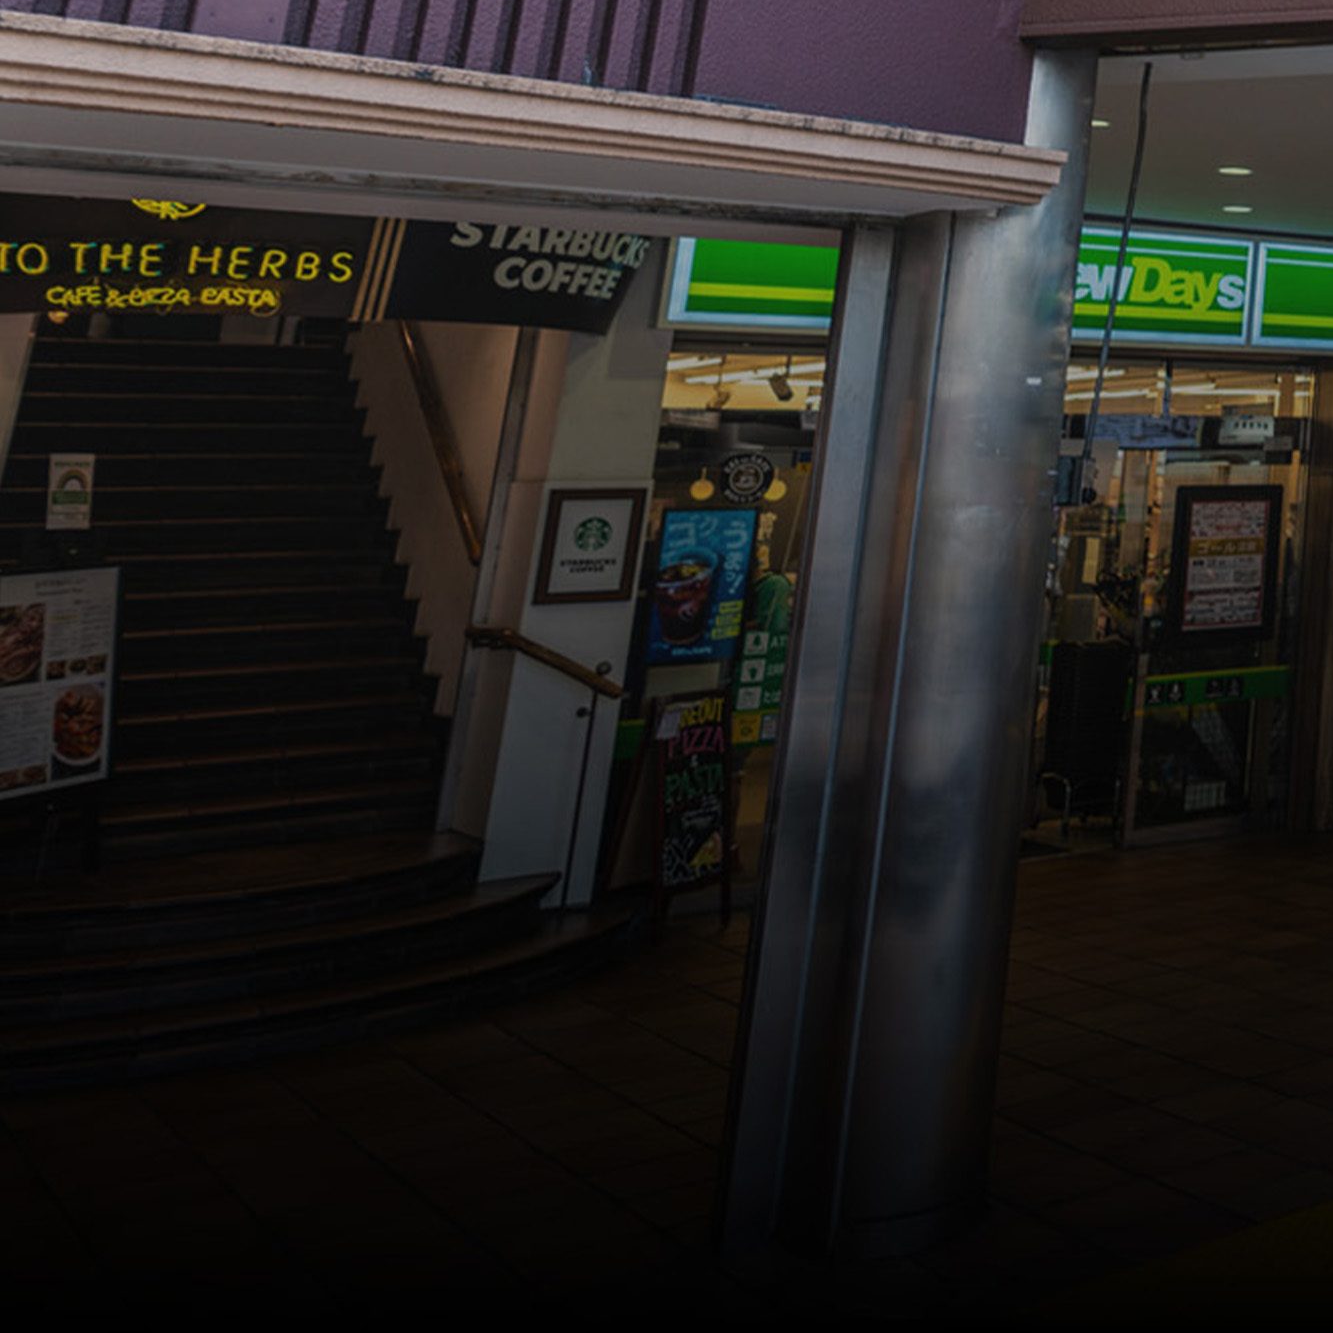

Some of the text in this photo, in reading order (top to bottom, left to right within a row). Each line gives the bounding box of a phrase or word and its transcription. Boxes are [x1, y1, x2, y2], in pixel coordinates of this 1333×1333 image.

[0, 242, 354, 283] TO THE HERBS
[450, 221, 650, 269] STARBUCKS
[492, 255, 622, 301] COFFEE
[1074, 255, 1246, 311] ewDays
